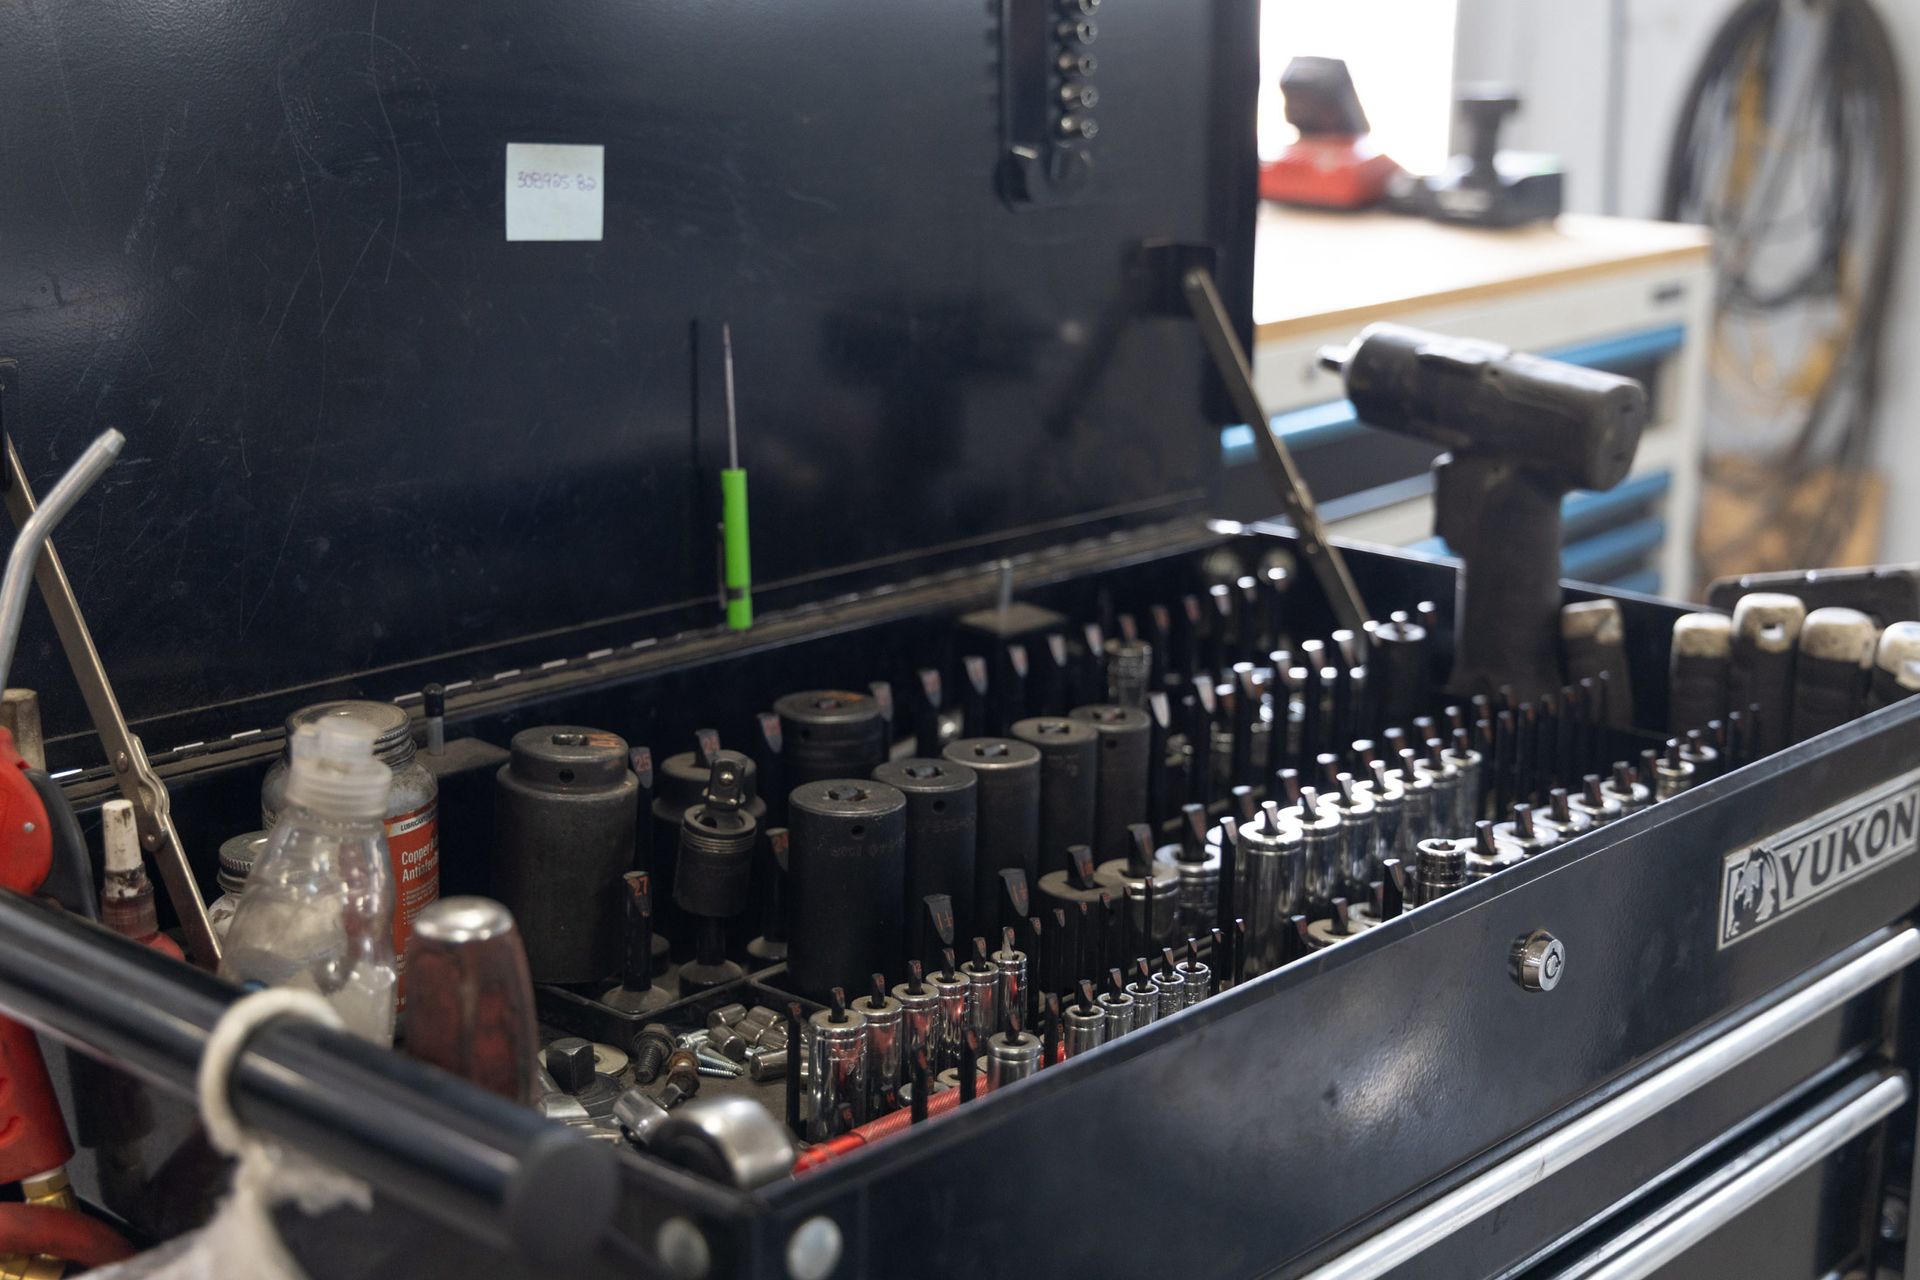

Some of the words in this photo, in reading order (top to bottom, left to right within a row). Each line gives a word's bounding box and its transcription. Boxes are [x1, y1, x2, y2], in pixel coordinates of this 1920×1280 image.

[634, 754, 651, 772] 25
[401, 843, 430, 866] Copper
[1779, 794, 1916, 900] YUKON
[627, 876, 649, 897] 27
